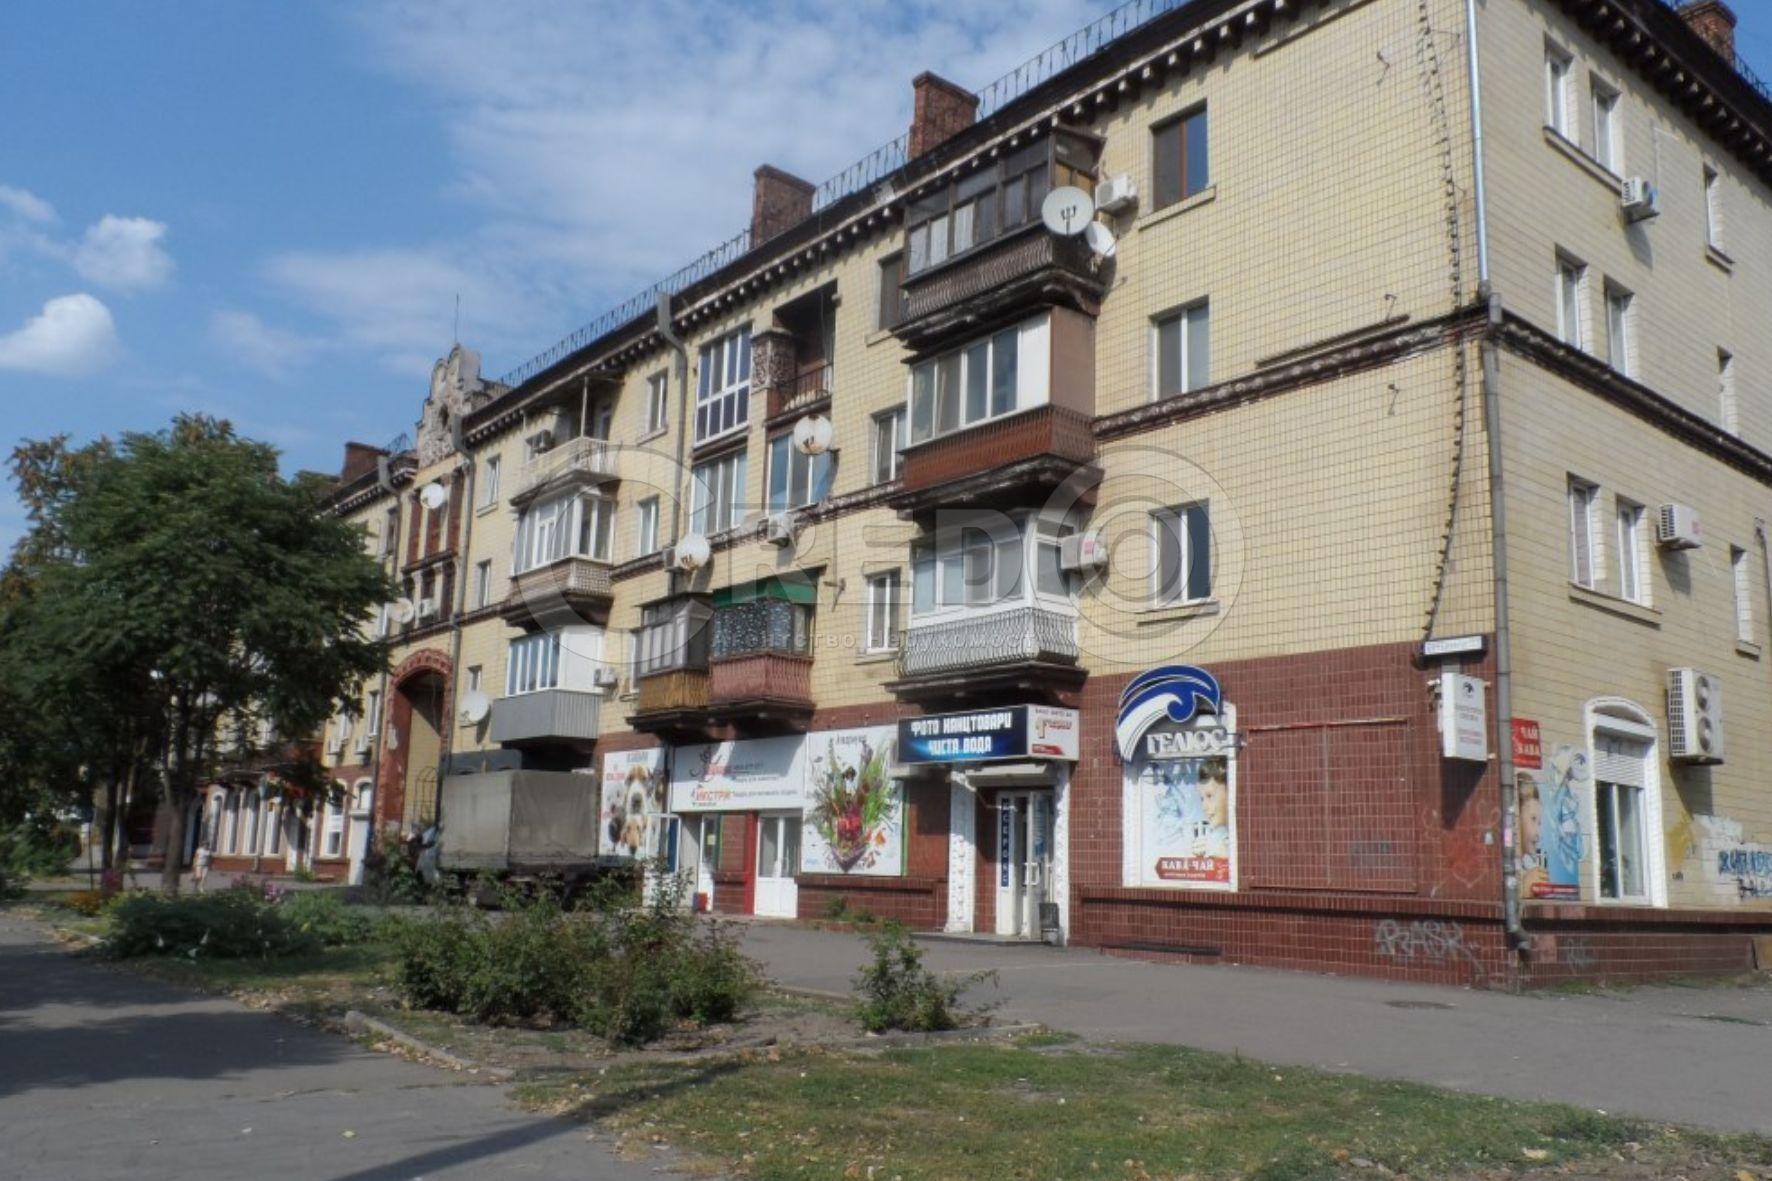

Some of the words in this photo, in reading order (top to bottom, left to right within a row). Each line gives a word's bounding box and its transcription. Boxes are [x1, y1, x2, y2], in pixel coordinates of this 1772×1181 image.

[911, 719, 939, 736] ФОТО
[943, 712, 1012, 734] КАНЦТОВАРИ
[928, 739, 959, 755] ЧИСТА
[963, 736, 992, 754] ВОДА
